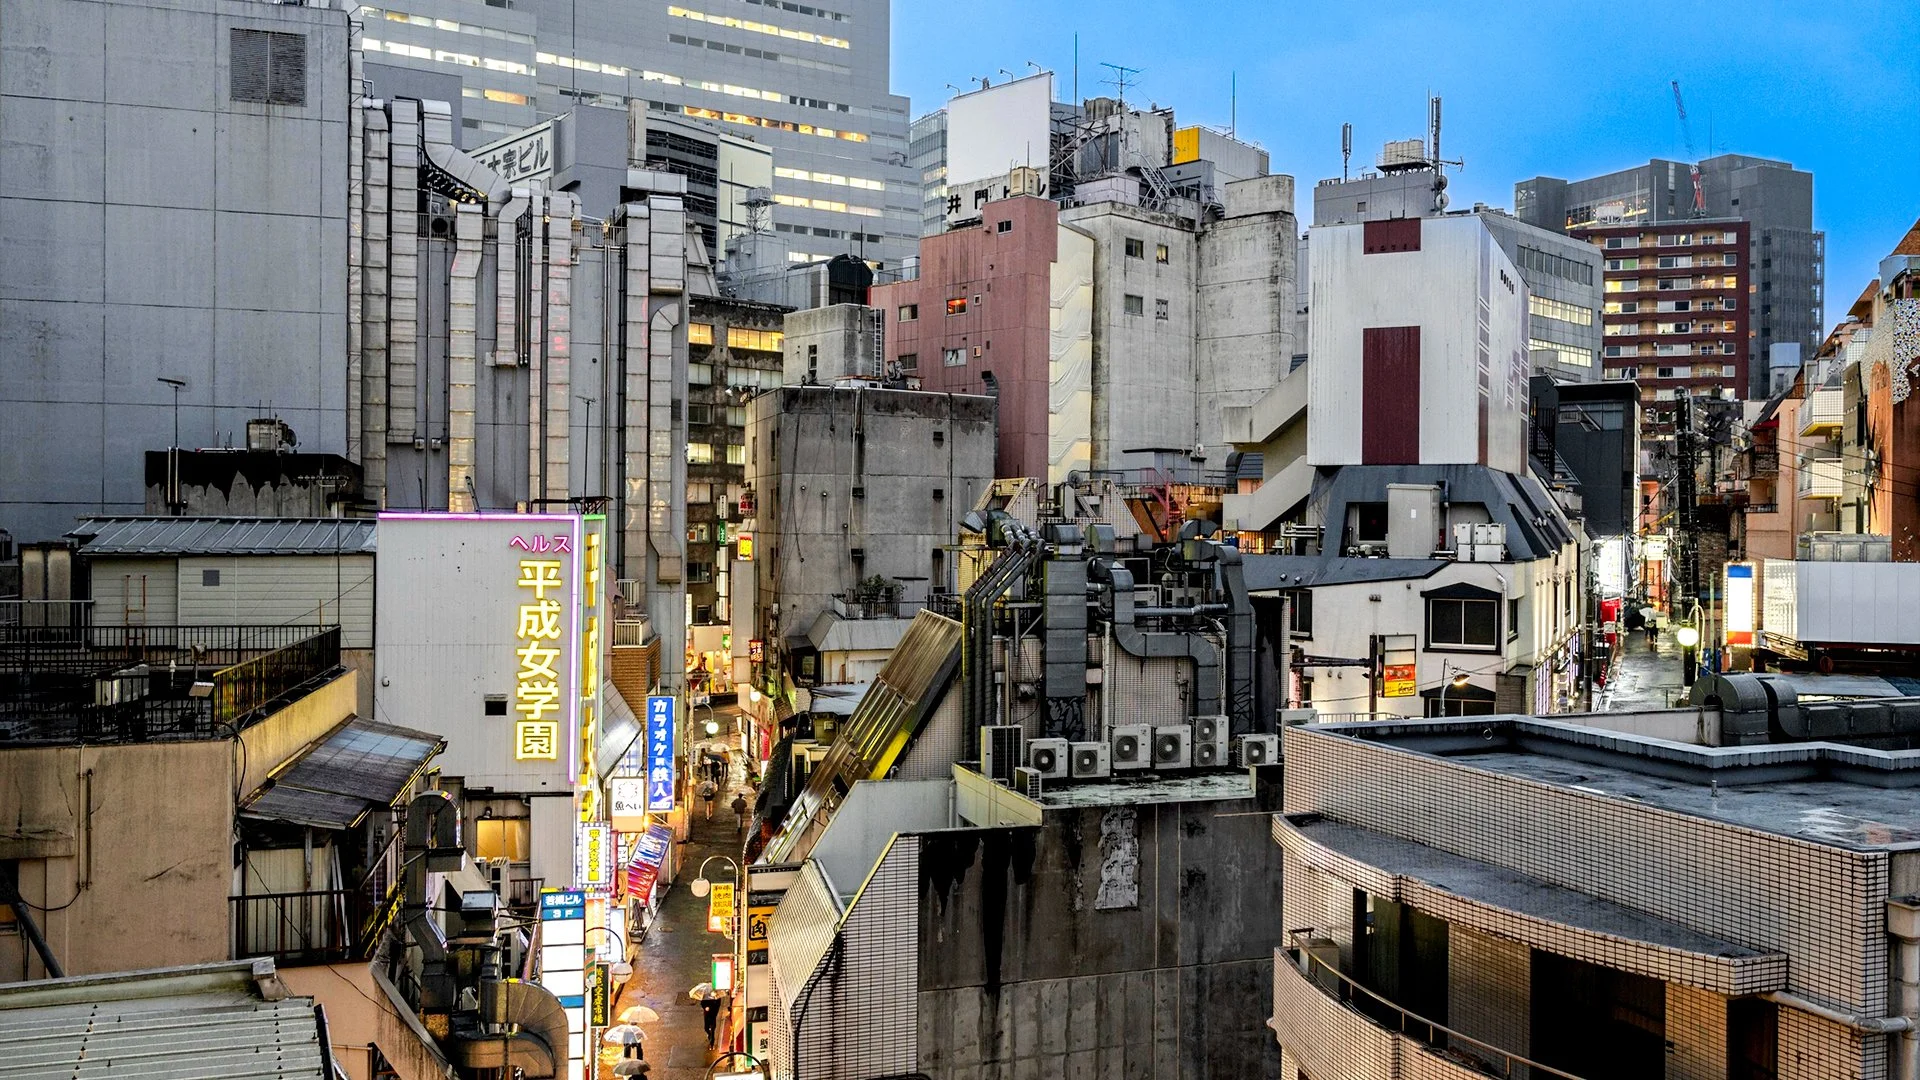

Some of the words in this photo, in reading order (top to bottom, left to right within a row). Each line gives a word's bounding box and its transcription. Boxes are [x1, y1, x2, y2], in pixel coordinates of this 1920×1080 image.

[480, 137, 549, 180] 大宗ビル
[509, 534, 572, 554] ヘルス
[515, 558, 563, 761] 平成女学園
[652, 699, 669, 798] カラオケ鉄人
